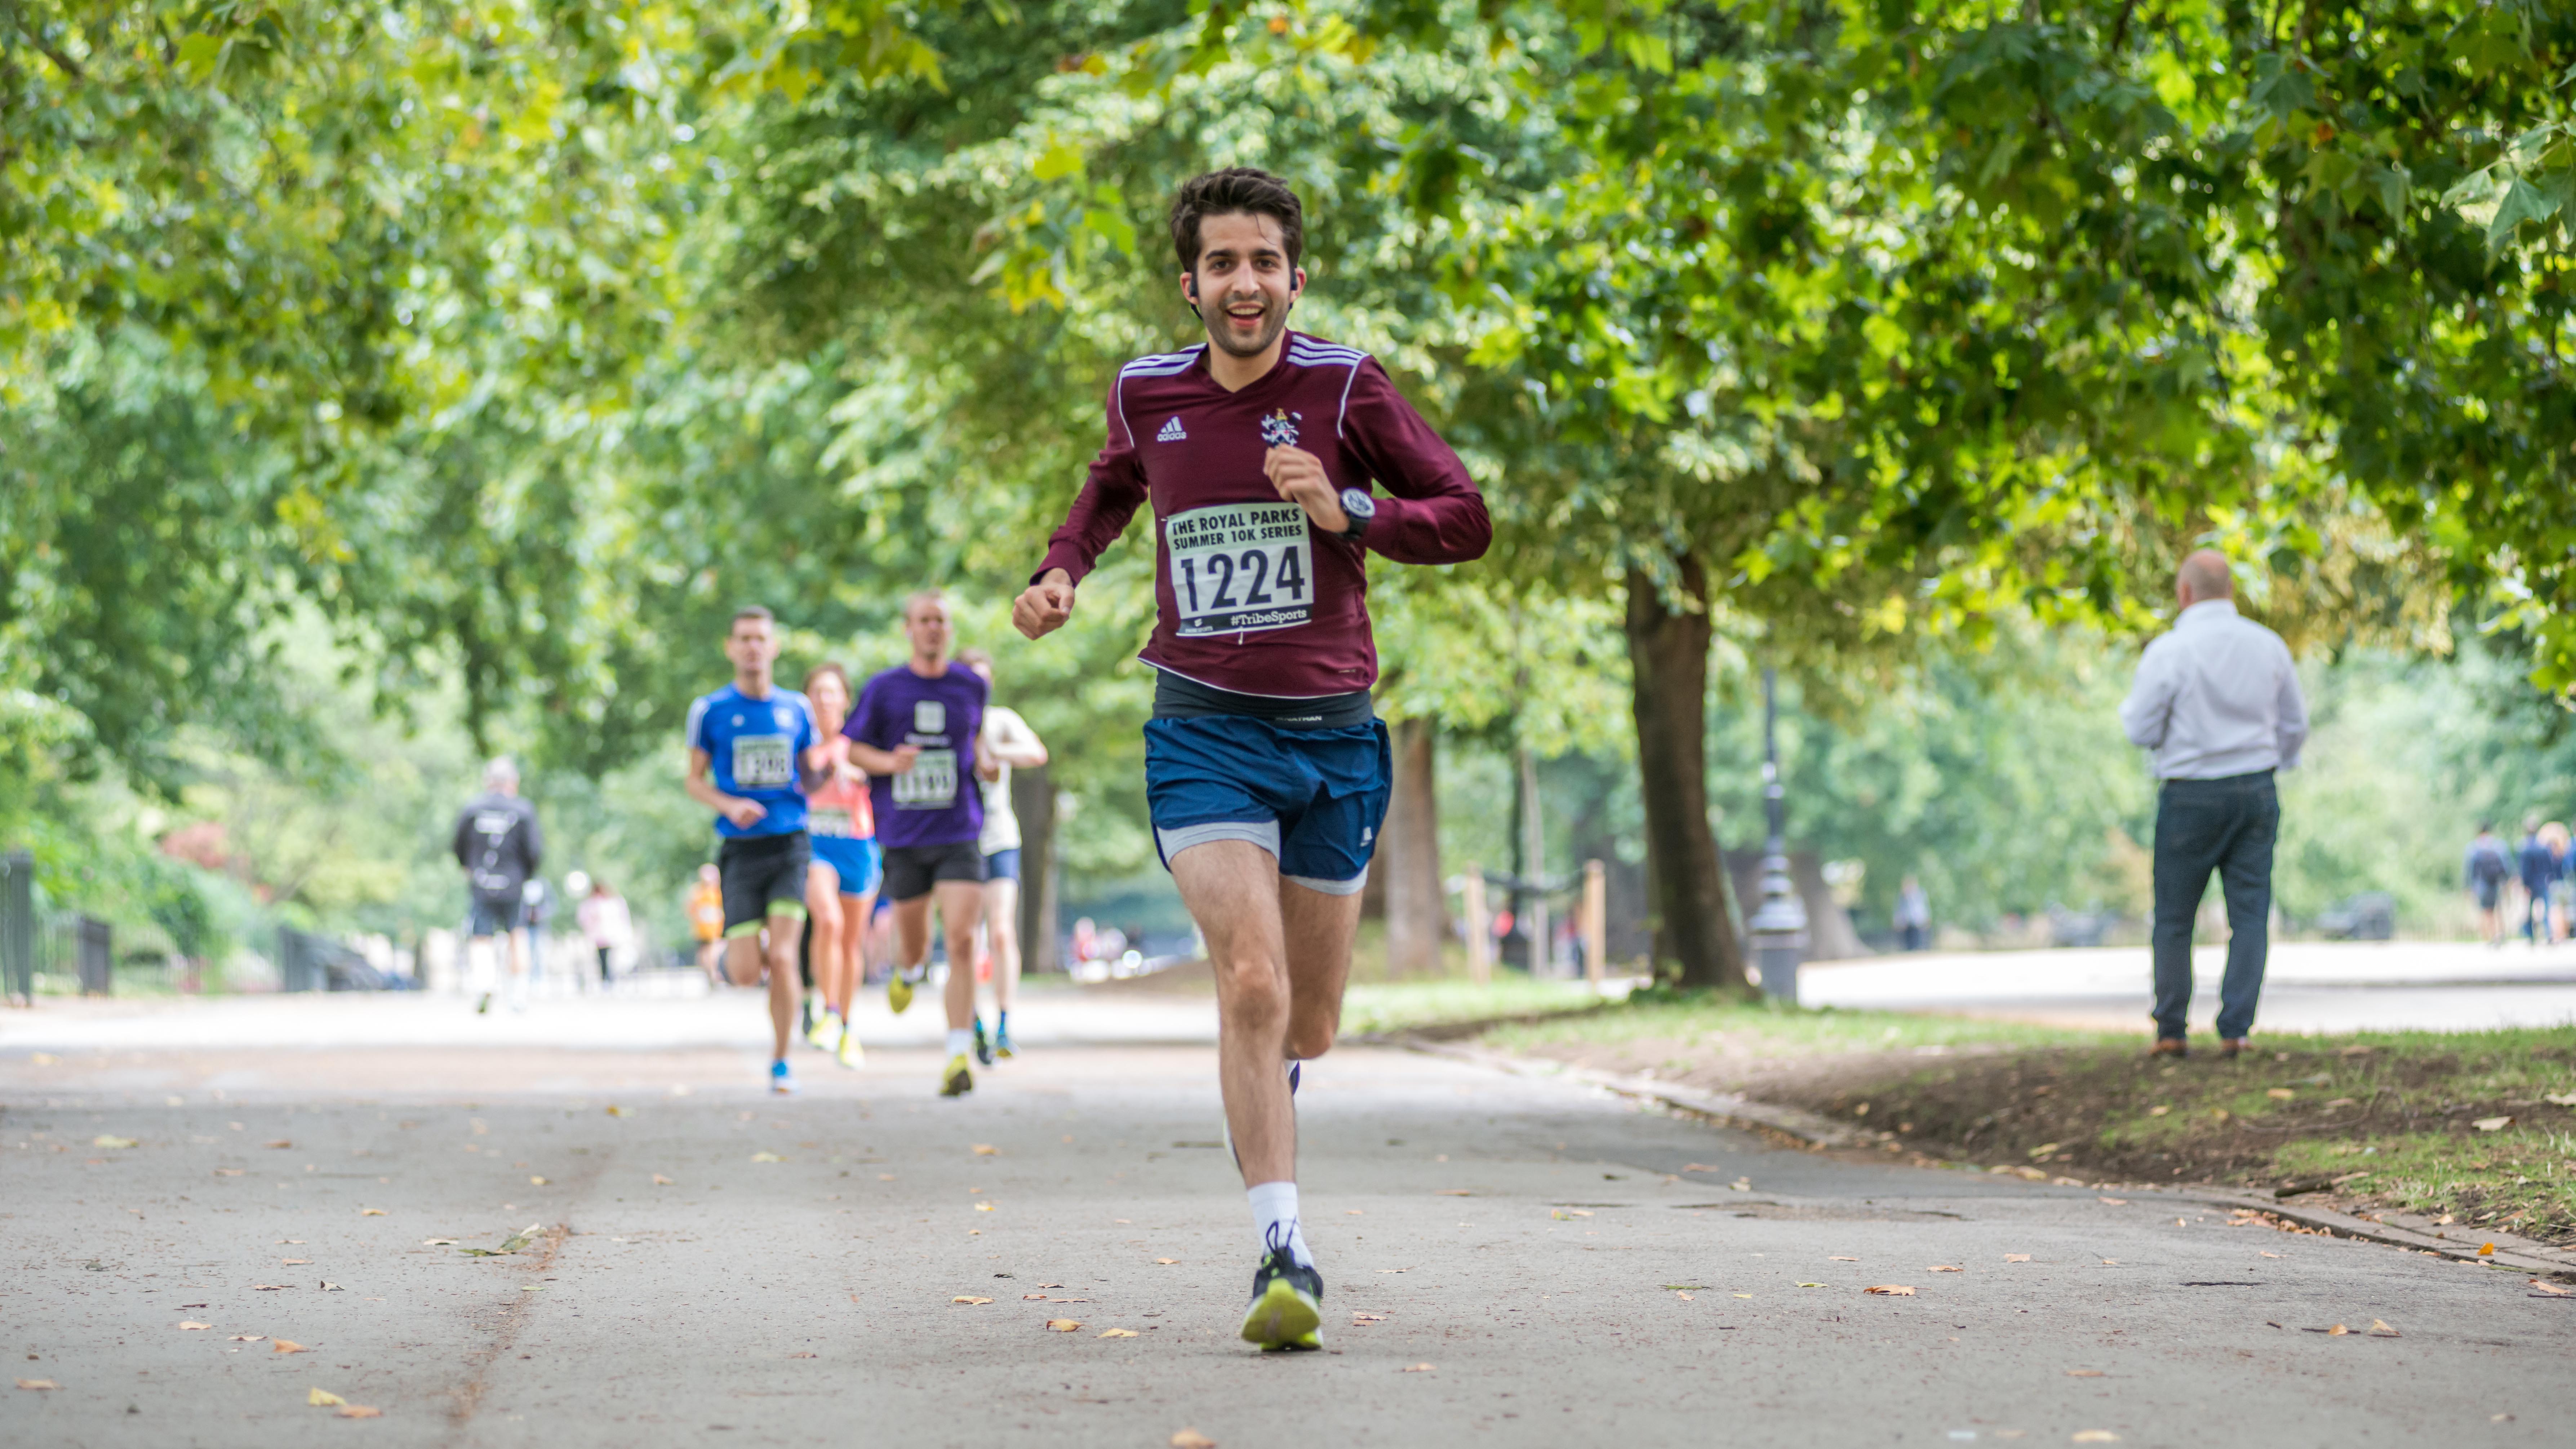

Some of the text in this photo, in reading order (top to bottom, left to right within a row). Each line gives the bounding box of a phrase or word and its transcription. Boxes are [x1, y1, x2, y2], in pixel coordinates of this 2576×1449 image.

[1157, 432, 1187, 442] adidas
[1172, 508, 1299, 535] THE ROYAL PARKS
[1174, 525, 1302, 550] SUMMER 10K SERIES
[1181, 546, 1305, 612] 1224
[1231, 609, 1307, 626] #TribeSports
